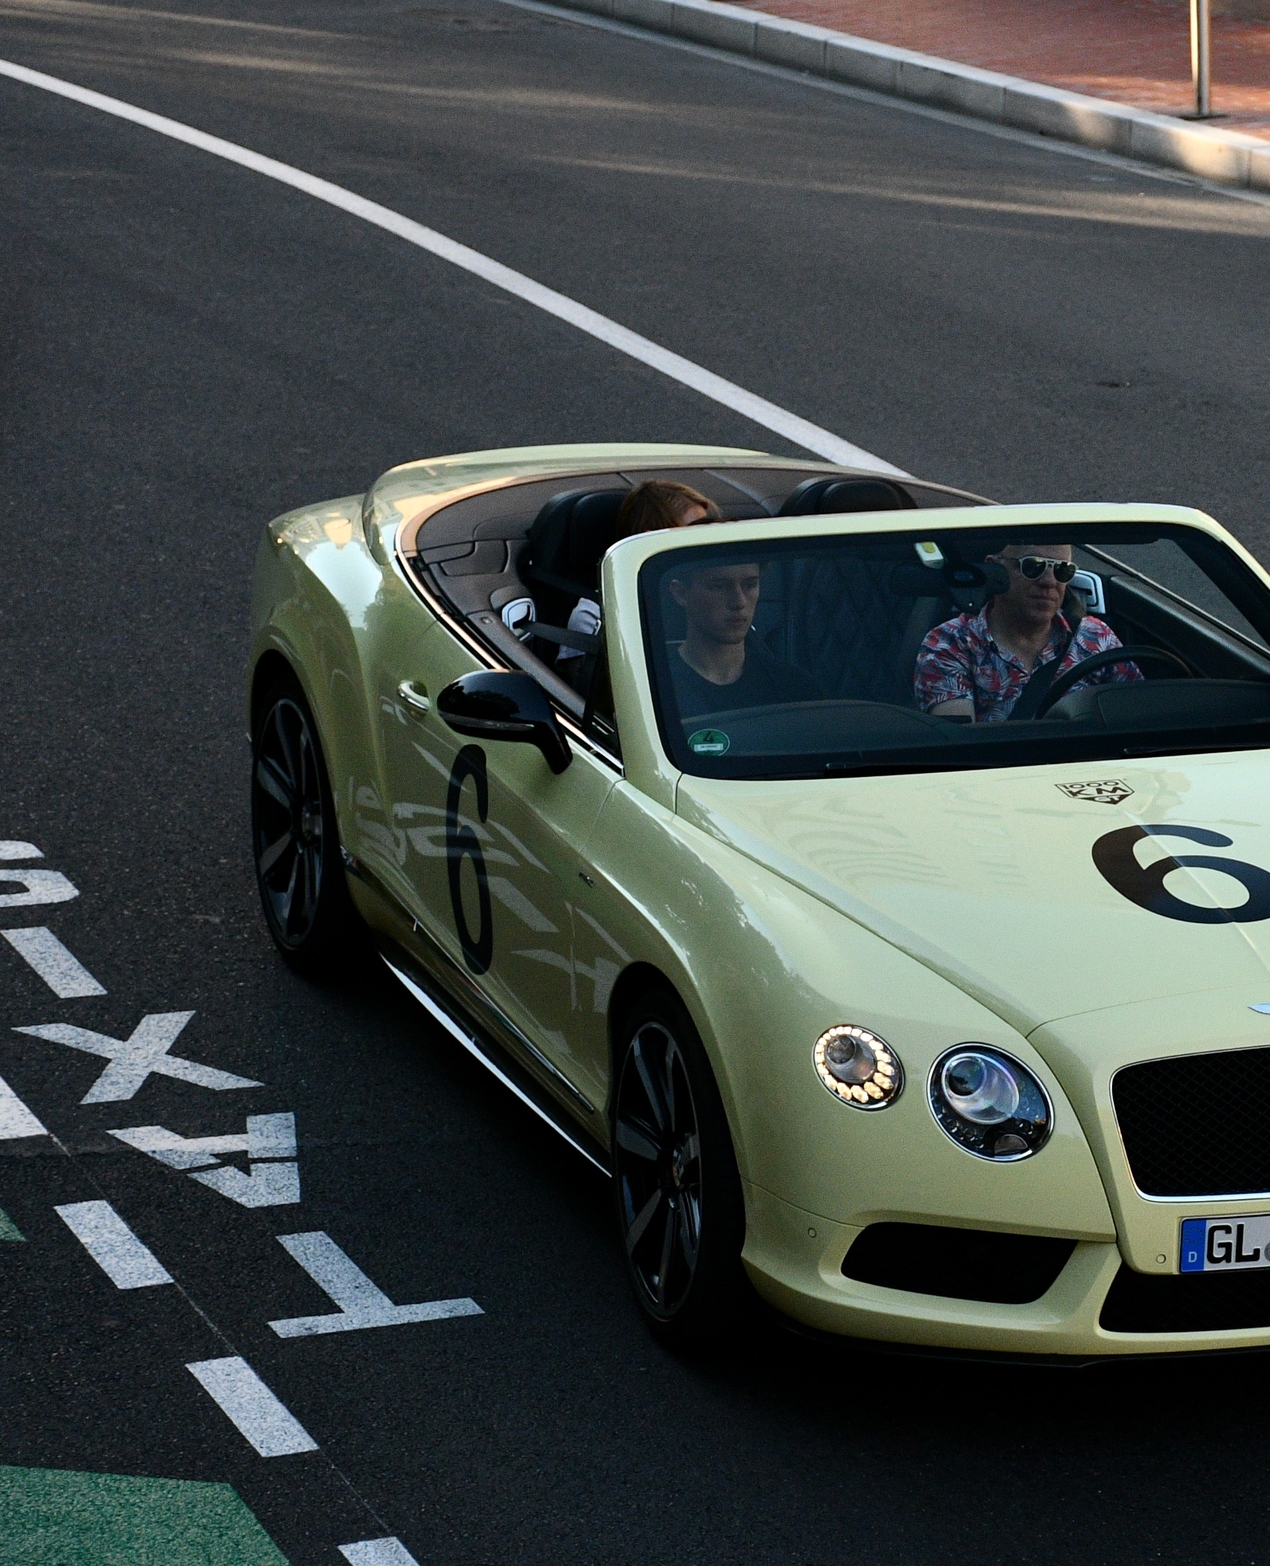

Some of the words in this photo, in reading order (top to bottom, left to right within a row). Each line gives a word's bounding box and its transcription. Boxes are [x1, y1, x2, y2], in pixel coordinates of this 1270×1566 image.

[1060, 781, 1119, 790] 1000
[1066, 786, 1130, 797] KM
[446, 744, 493, 975] 6
[1206, 1223, 1261, 1264] GL
[1188, 1251, 1198, 1264] D
